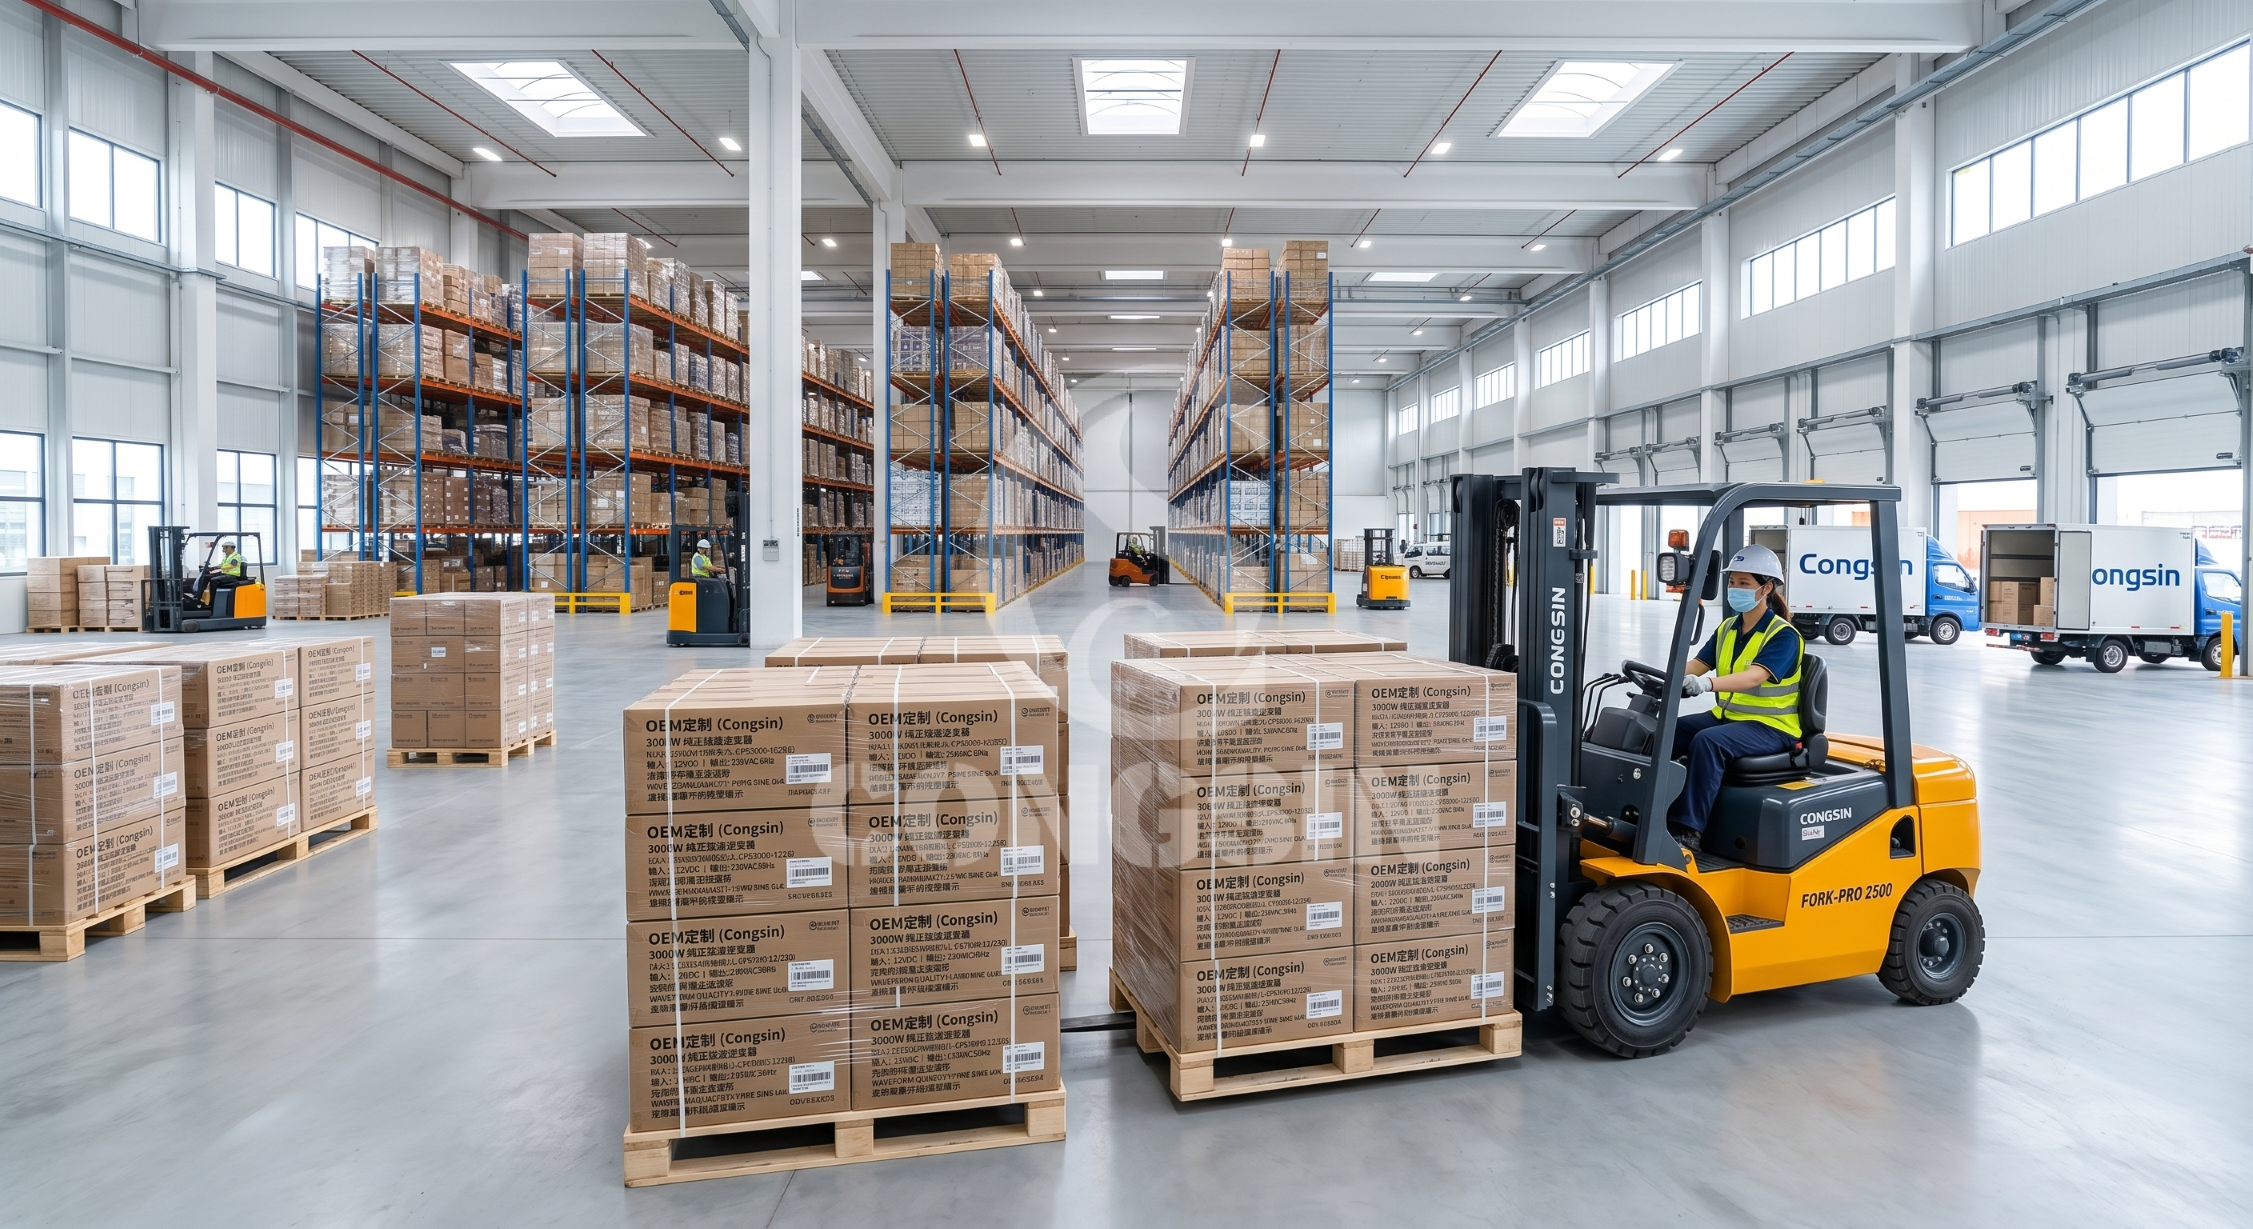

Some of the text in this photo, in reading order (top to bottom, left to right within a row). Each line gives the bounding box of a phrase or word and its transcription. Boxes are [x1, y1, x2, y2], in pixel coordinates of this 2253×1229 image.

[1799, 554, 1913, 580] Congn
[2092, 564, 2180, 591] ongsin
[1551, 588, 1566, 694] CONGSIN
[1254, 691, 1305, 705] (Congsin)
[1423, 686, 1471, 698] (Congsin)
[1197, 709, 1225, 717] 300W
[1372, 703, 1398, 711] 3000W
[646, 717, 783, 733] OEM定制 (Congsin)
[868, 710, 998, 725] OEM定制 (Congsin)
[646, 738, 680, 747] 300W
[1423, 772, 1470, 786] (Congsin)
[1253, 782, 1305, 797] (Congsin)
[1372, 791, 1396, 799] 3000W
[869, 812, 998, 828] OEM定制 (Congsin)
[1800, 807, 1852, 825] CONGSIN
[647, 821, 784, 839] OEM定制 (Congsin)
[1422, 859, 1469, 874] (Congsin)
[1253, 872, 1304, 887] (Congsin)
[1197, 894, 1224, 903] 300W
[1801, 883, 1892, 908] FORK-PRO 2500
[870, 911, 998, 930] OEM定制 (Congsin)
[649, 925, 785, 945] OEM定制 (Congsin)
[870, 934, 903, 944] 3000W
[649, 950, 684, 959] 3000W
[1422, 944, 1468, 960] (Congsin)
[1253, 961, 1304, 978] (Congsin)
[1371, 967, 1397, 975] 3000W
[871, 1010, 998, 1031] OEM定制 (Congsin)
[721, 1028, 785, 1047] (Congsin)
[871, 1034, 904, 1045] 3000W
